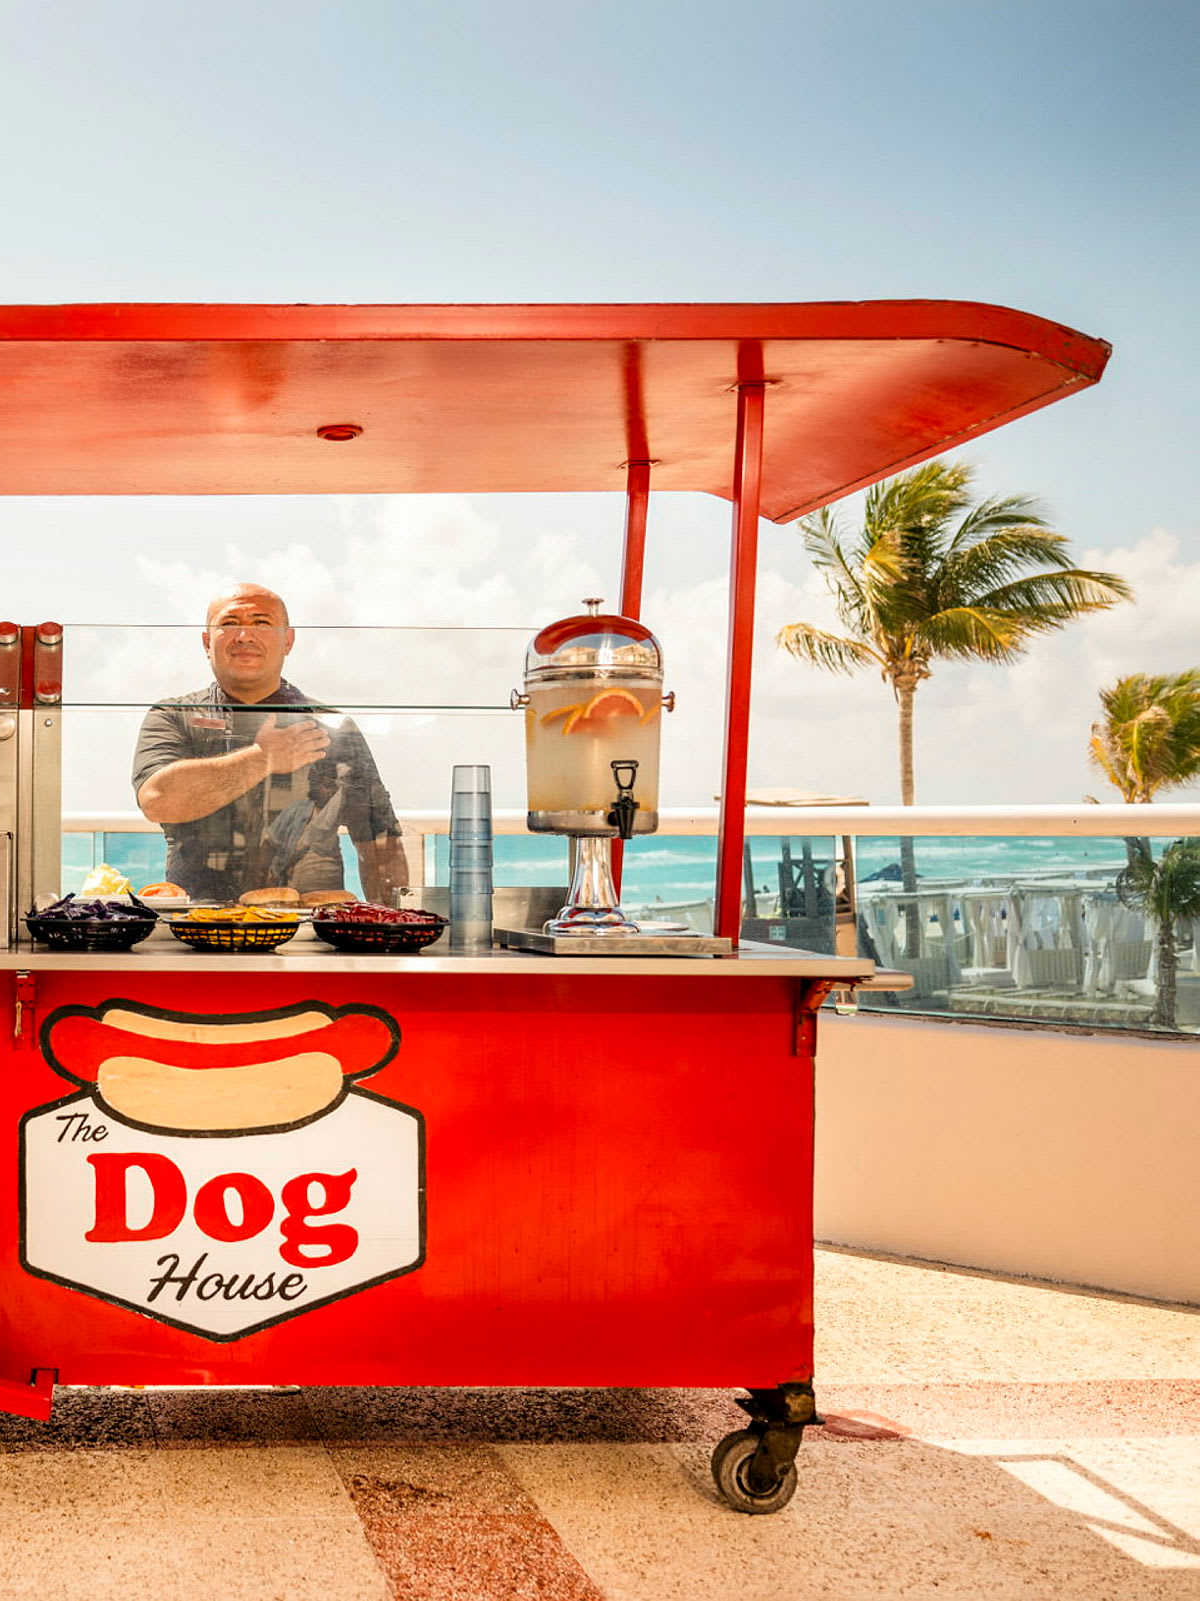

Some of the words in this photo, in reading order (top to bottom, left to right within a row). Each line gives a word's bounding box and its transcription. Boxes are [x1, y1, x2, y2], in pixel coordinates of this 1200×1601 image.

[56, 1113, 109, 1143] The
[85, 1152, 359, 1269] Dog
[146, 1252, 308, 1303] House
